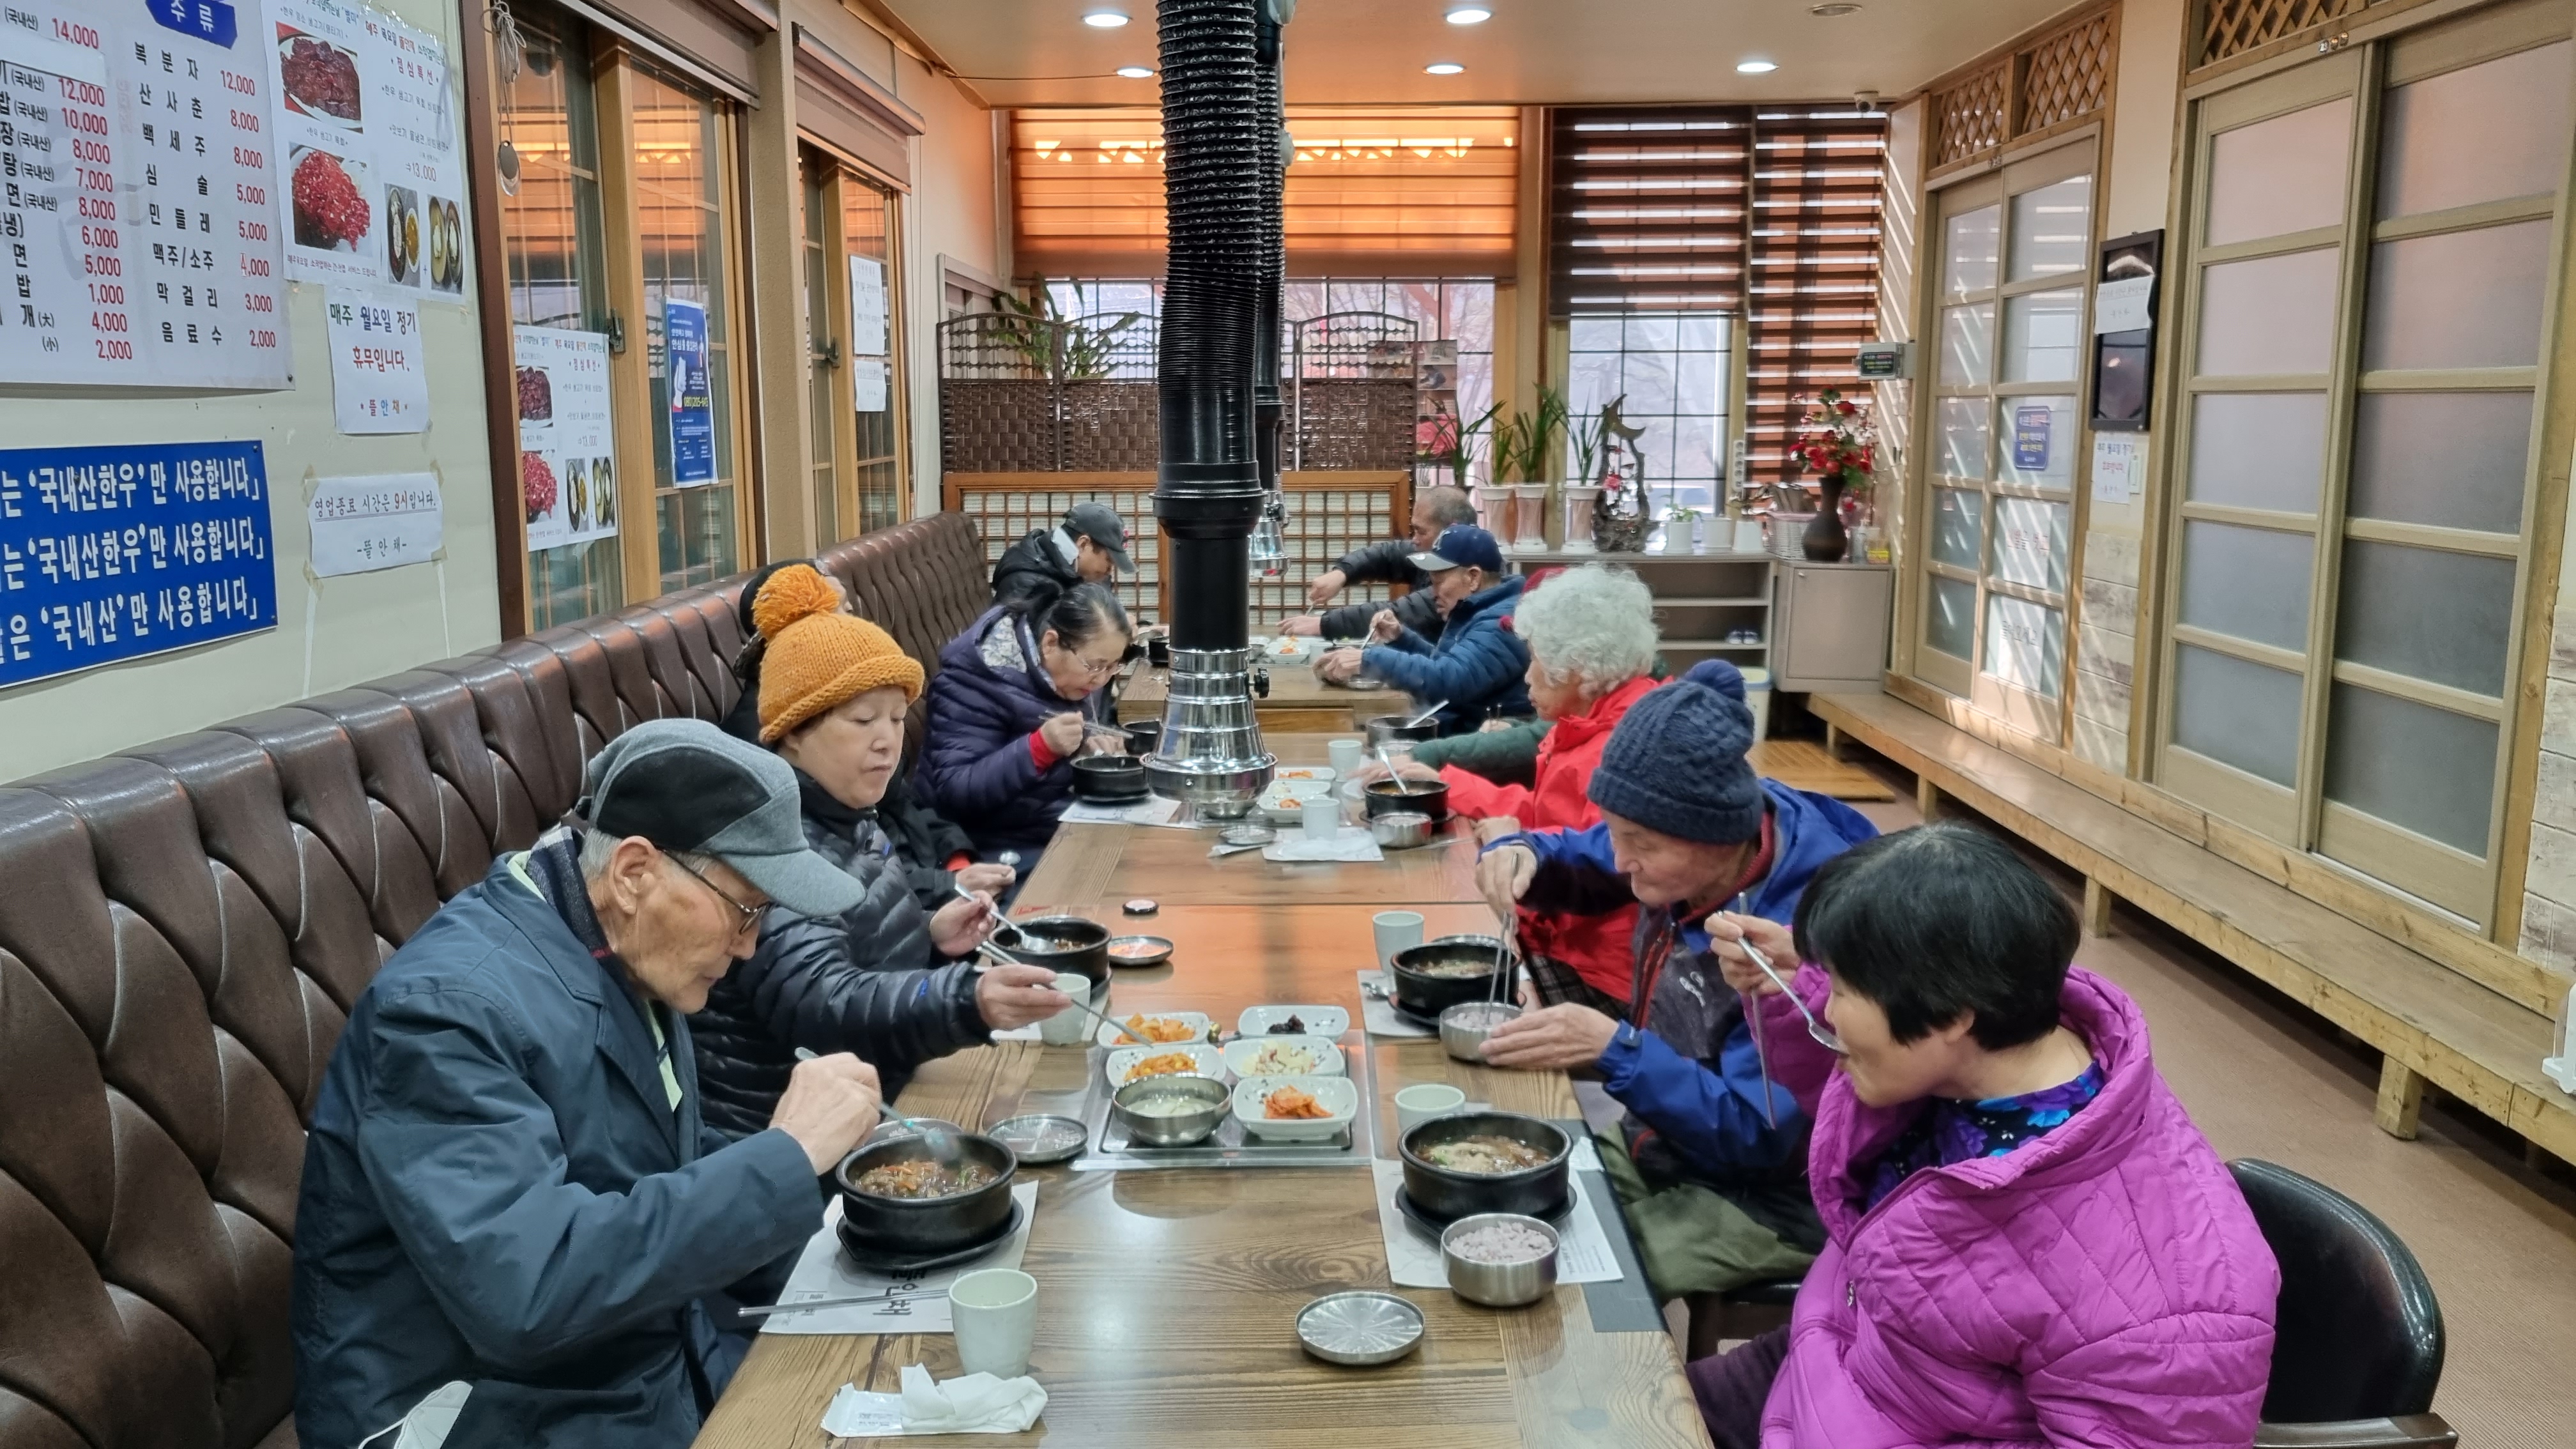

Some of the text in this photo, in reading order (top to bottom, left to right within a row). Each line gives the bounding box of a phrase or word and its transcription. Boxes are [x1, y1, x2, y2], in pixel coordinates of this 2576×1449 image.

[4, 6, 98, 49] (국내산) 14,000
[12, 68, 45, 92] (국내산)
[58, 77, 105, 107] 12,000
[220, 70, 256, 96] 12,000
[14, 100, 48, 122] (국내산)
[61, 107, 108, 136] 10,000
[230, 109, 259, 133] 8,000
[17, 131, 51, 153] (국내산)
[73, 138, 111, 164] 8,000
[234, 146, 263, 169] 8,000
[20, 161, 55, 183] (국내산)
[75, 167, 113, 192] 7,000
[24, 192, 58, 212] (국내산)
[79, 196, 116, 221] 8,000
[236, 183, 266, 205] 5,000
[81, 226, 118, 249] 6,000
[238, 220, 267, 241] 5,000
[84, 254, 121, 277] 5,000
[152, 242, 270, 277] 맥주/소주 4,000
[88, 283, 124, 305] 1,000
[245, 293, 272, 312] 3,000
[91, 311, 128, 332] 4,000
[330, 303, 416, 335] 매주 월요일 정기
[96, 339, 132, 361] 2,000
[249, 330, 276, 348] 2,000
[353, 346, 410, 372] 휴무입니다.
[315, 490, 436, 518] 영업종료 시간은 9시입니다.
